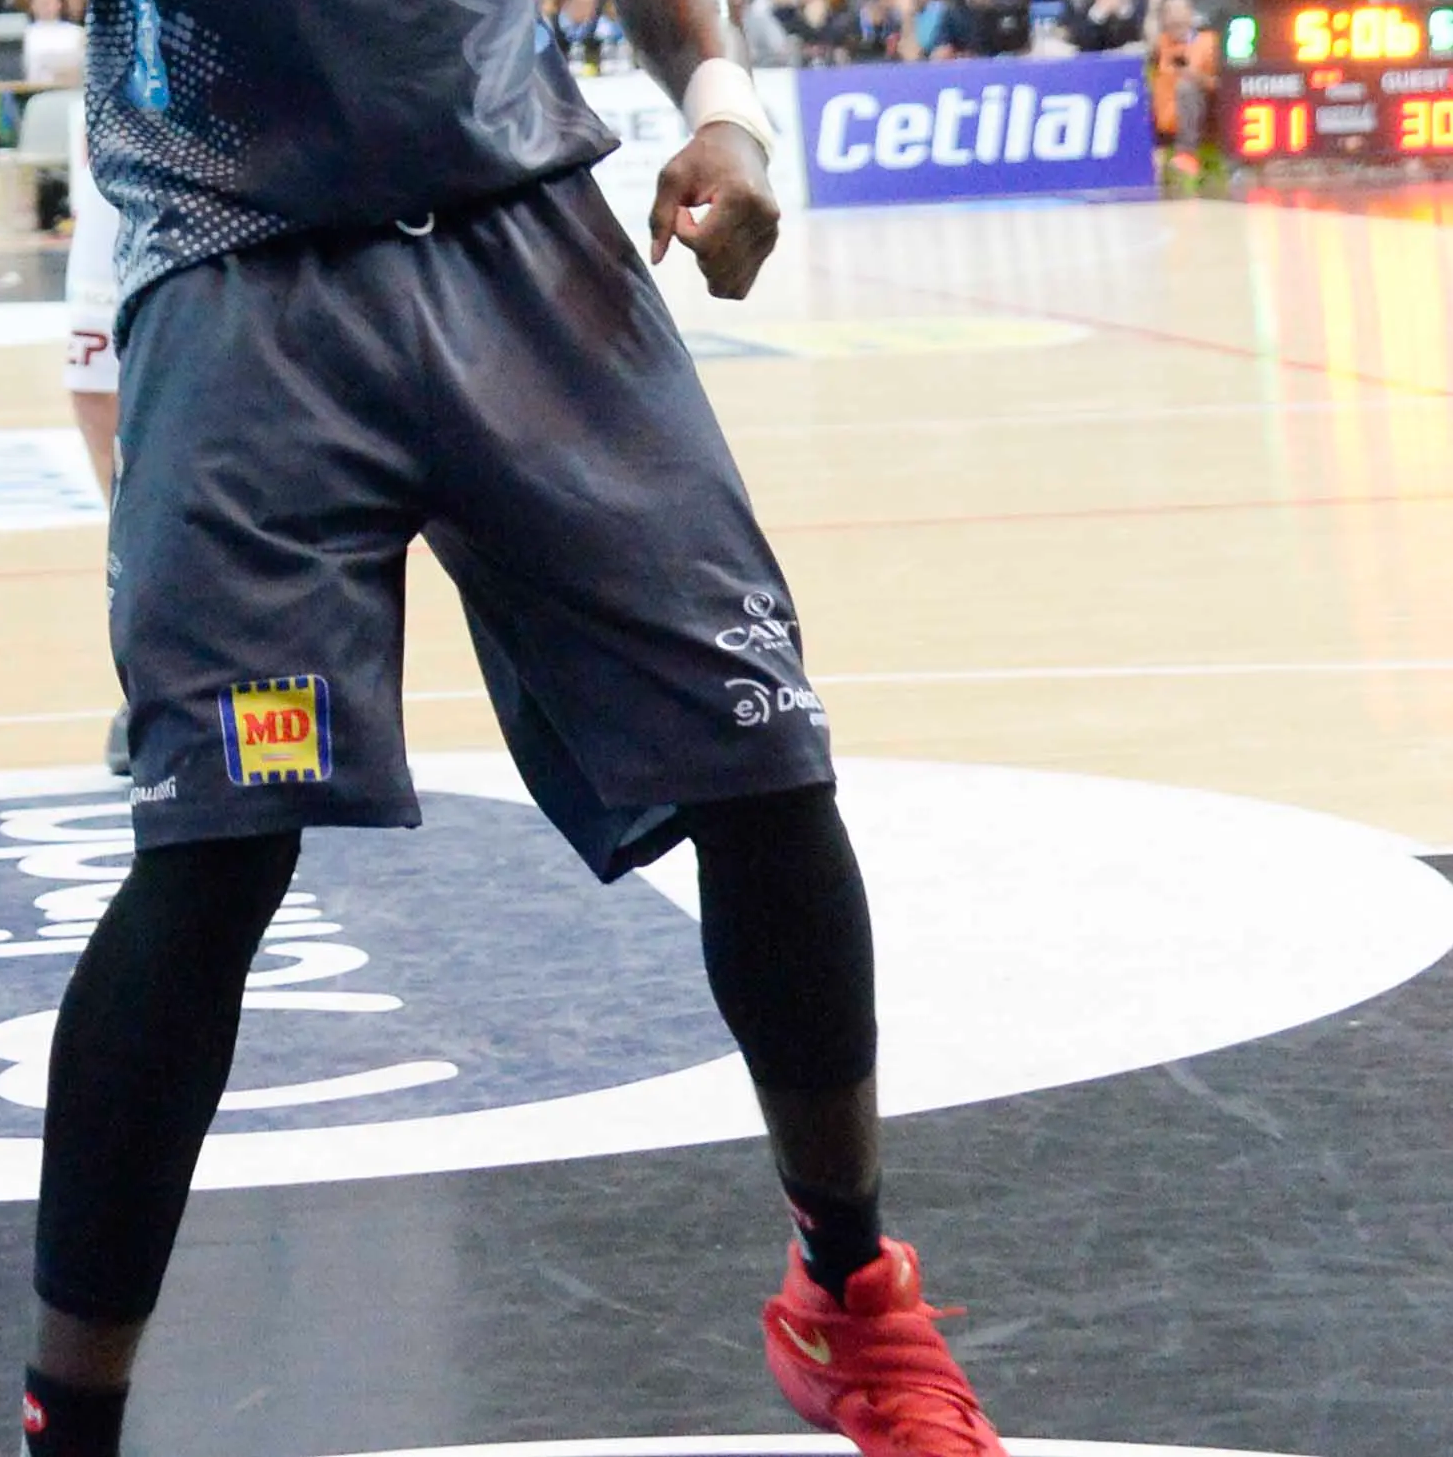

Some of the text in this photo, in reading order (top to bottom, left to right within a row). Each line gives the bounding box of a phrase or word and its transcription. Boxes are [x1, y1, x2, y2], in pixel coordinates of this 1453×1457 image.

[1293, 7, 1421, 61] 5:06
[1240, 73, 1305, 98] HOME
[815, 82, 1139, 174] Cetilar
[1239, 103, 1310, 156] 31
[243, 707, 312, 747] MD
